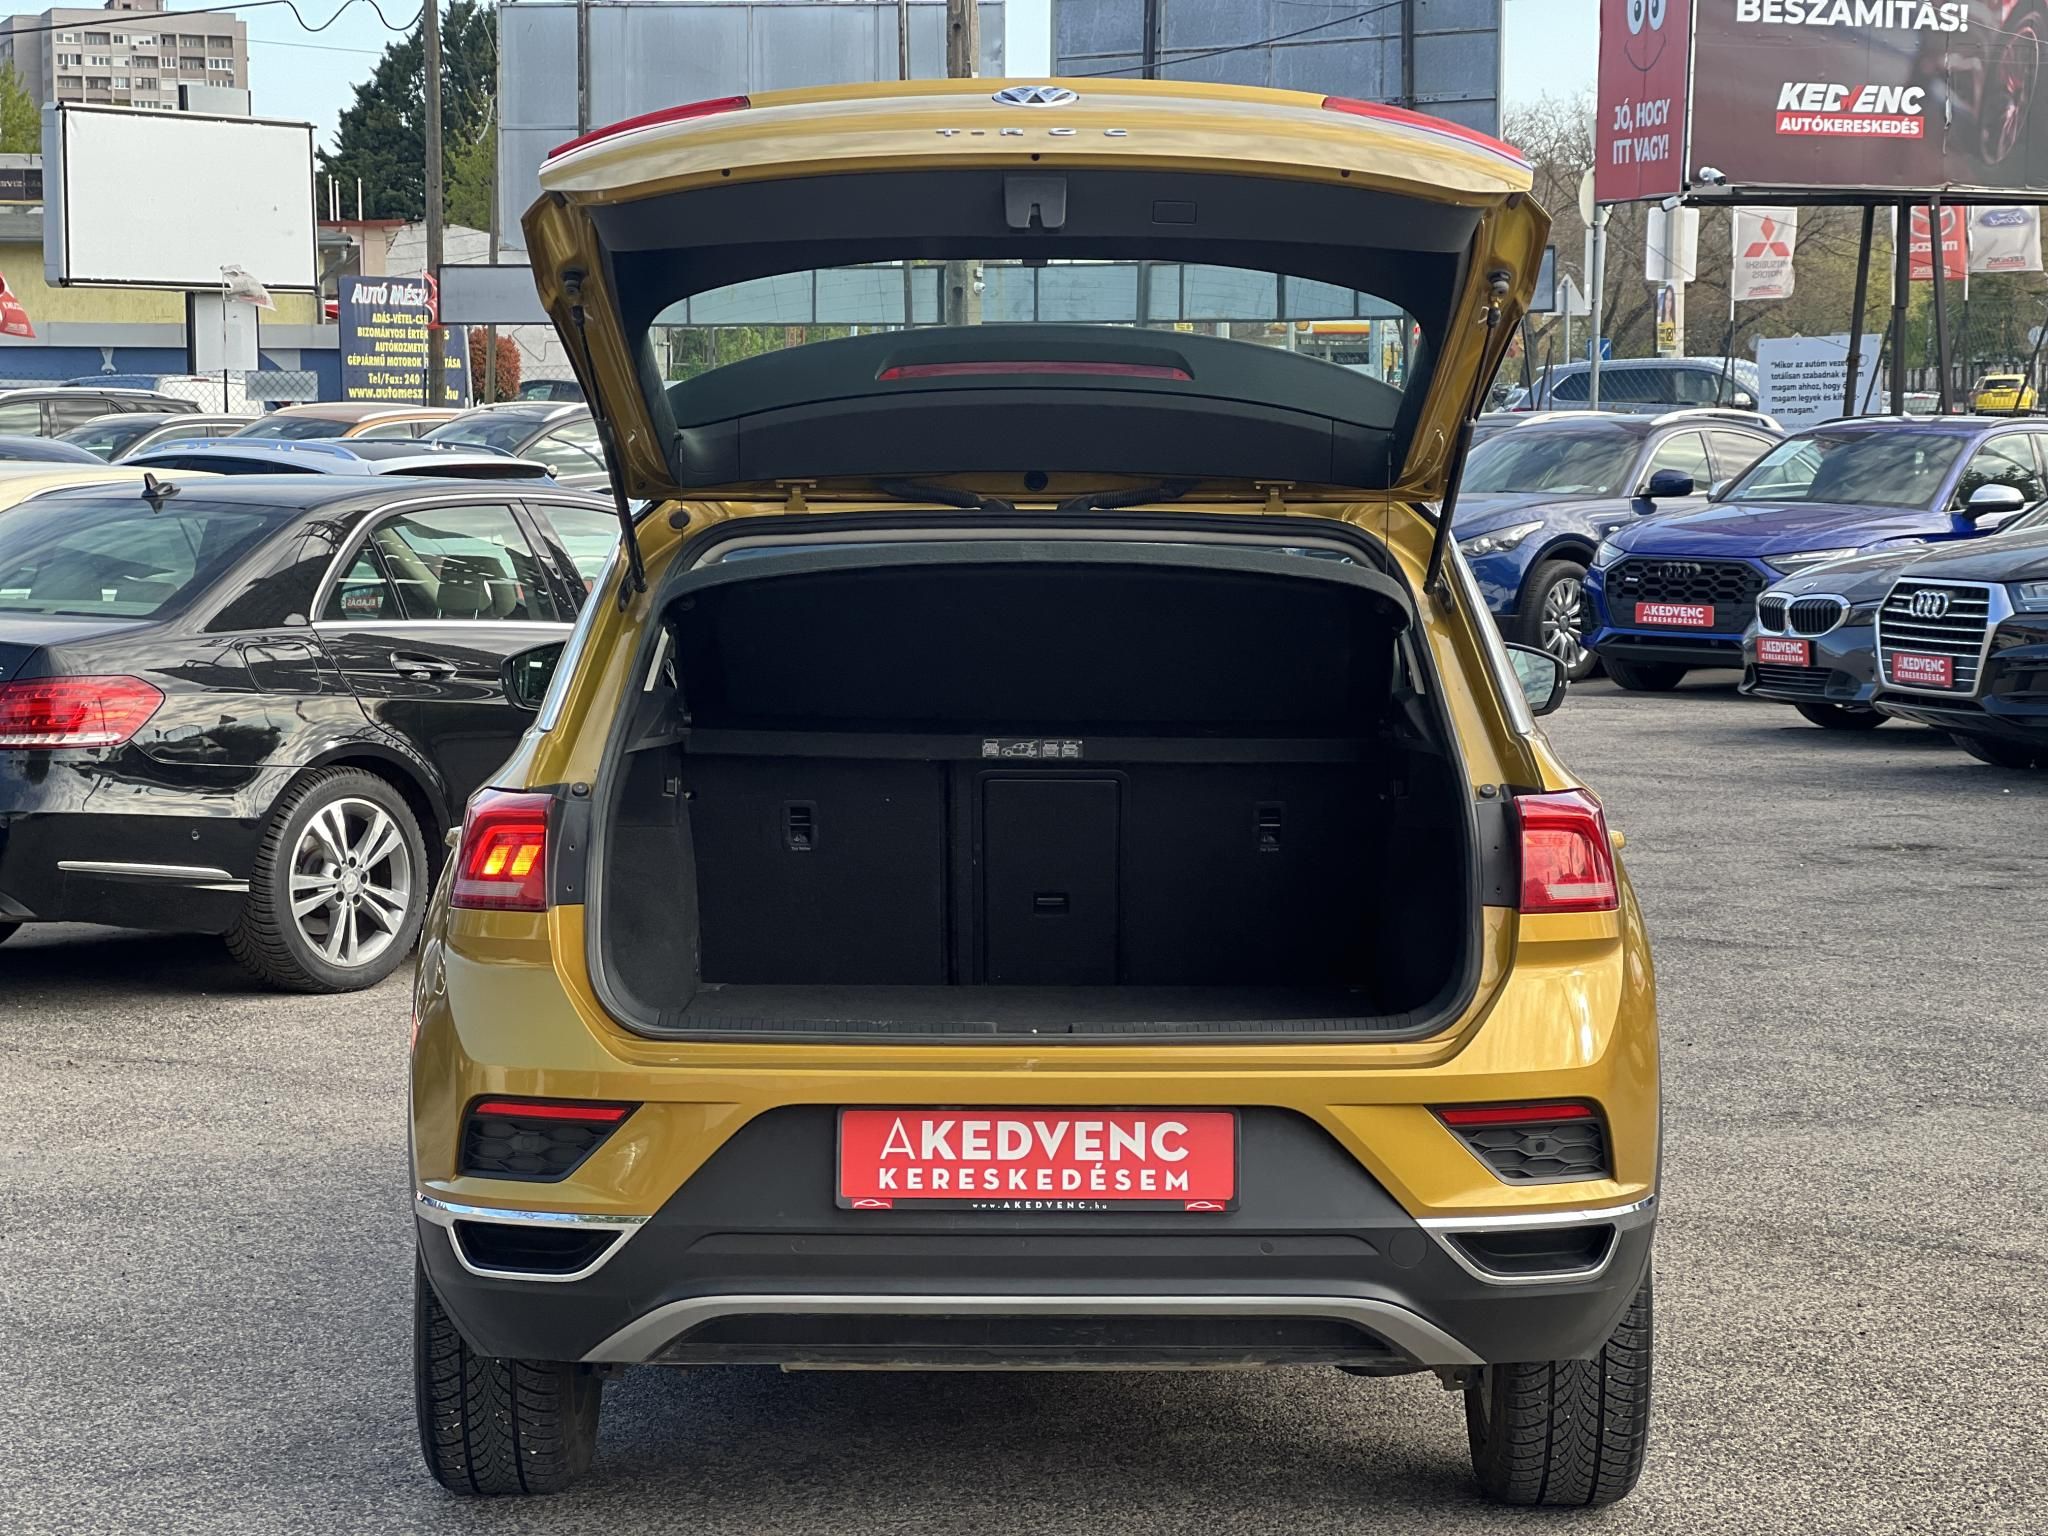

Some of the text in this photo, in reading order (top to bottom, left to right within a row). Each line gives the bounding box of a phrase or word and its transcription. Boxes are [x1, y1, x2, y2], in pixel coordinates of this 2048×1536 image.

[1776, 82, 1925, 115] KEDVENC
[1613, 97, 1671, 133] JÓ, HOGY
[1780, 116, 1919, 134] AUTÓKERESKEDÉS
[1613, 134, 1669, 165] ITT VAGY!
[351, 282, 388, 305] AUTÓ
[386, 357, 422, 367] MOTOROK
[1771, 372, 1801, 380] totálisan
[1802, 371, 1840, 379] szabadnak
[1771, 383, 1797, 392] magam
[1823, 381, 1840, 391] hogy
[1771, 394, 1797, 403] magam
[1799, 393, 1822, 403] legyek
[1823, 392, 1831, 401] és
[1771, 406, 1785, 414] zem
[1643, 605, 1704, 618] AKEDVENC
[1761, 640, 1803, 654] AKEDVENC
[1898, 656, 1945, 673] AKEDVENC
[879, 1117, 1190, 1162] AKEDVENC
[879, 1164, 1190, 1191] KERESKEDÉSEM
